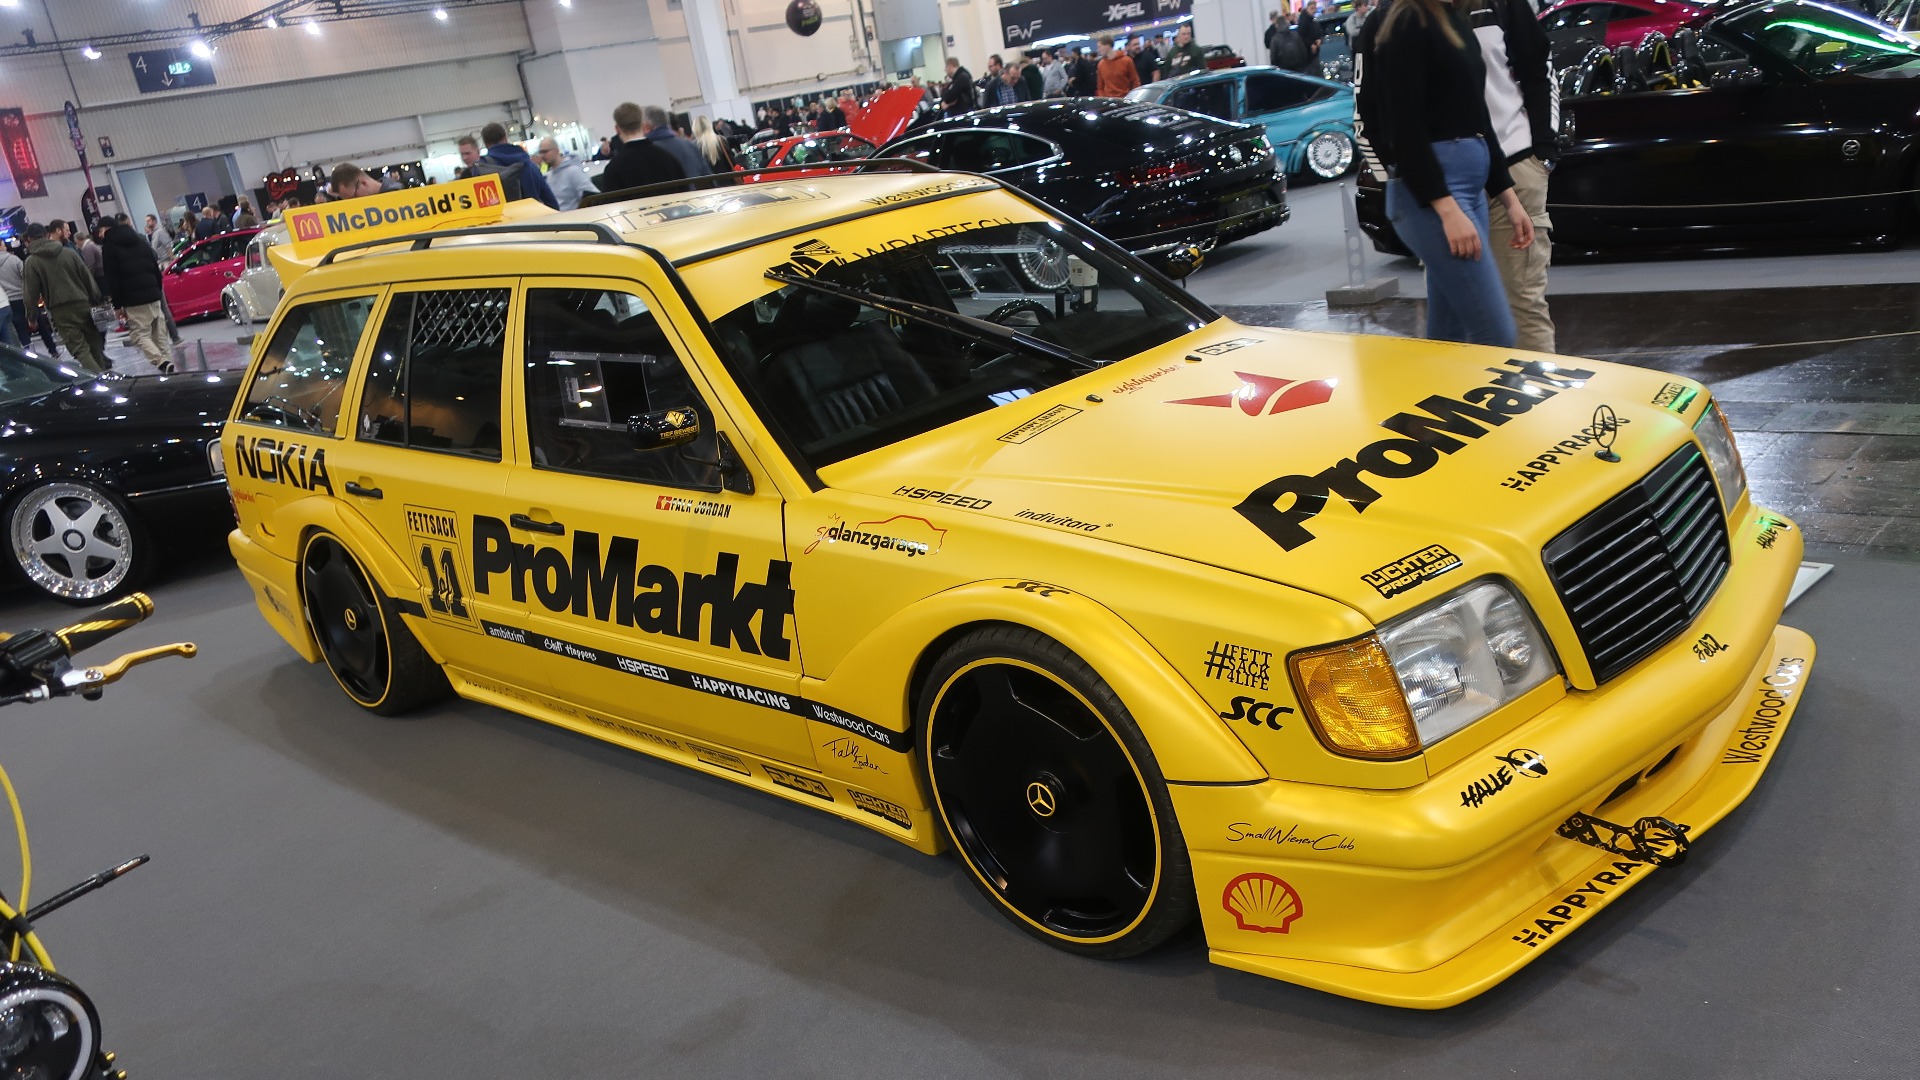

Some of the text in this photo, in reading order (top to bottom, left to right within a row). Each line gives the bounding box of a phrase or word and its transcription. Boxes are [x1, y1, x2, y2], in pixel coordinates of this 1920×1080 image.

[1103, 2, 1145, 22] XPEL
[135, 56, 148, 74] 4
[193, 197, 202, 207] 4
[325, 192, 472, 234] McDonald's
[236, 435, 335, 497] NOKIA
[1232, 359, 1596, 552] ProMarkt
[407, 510, 457, 538] FETTSACK
[671, 498, 731, 518] FALK JORDAN
[828, 521, 929, 557] glanzgarage
[1364, 545, 1449, 588] LICHTER
[473, 514, 795, 661] ProMarkt
[1001, 581, 1070, 597] SCC
[1226, 671, 1269, 691] 4LIFE
[1228, 658, 1270, 680] SACK
[691, 674, 791, 711] HAPPYRACING
[1721, 657, 1805, 764] Westwood Cars
[812, 704, 890, 745] Westwood Cars
[1219, 695, 1294, 731] SCC
[849, 790, 908, 818] LICHTER
[1460, 764, 1514, 809] HALLE
